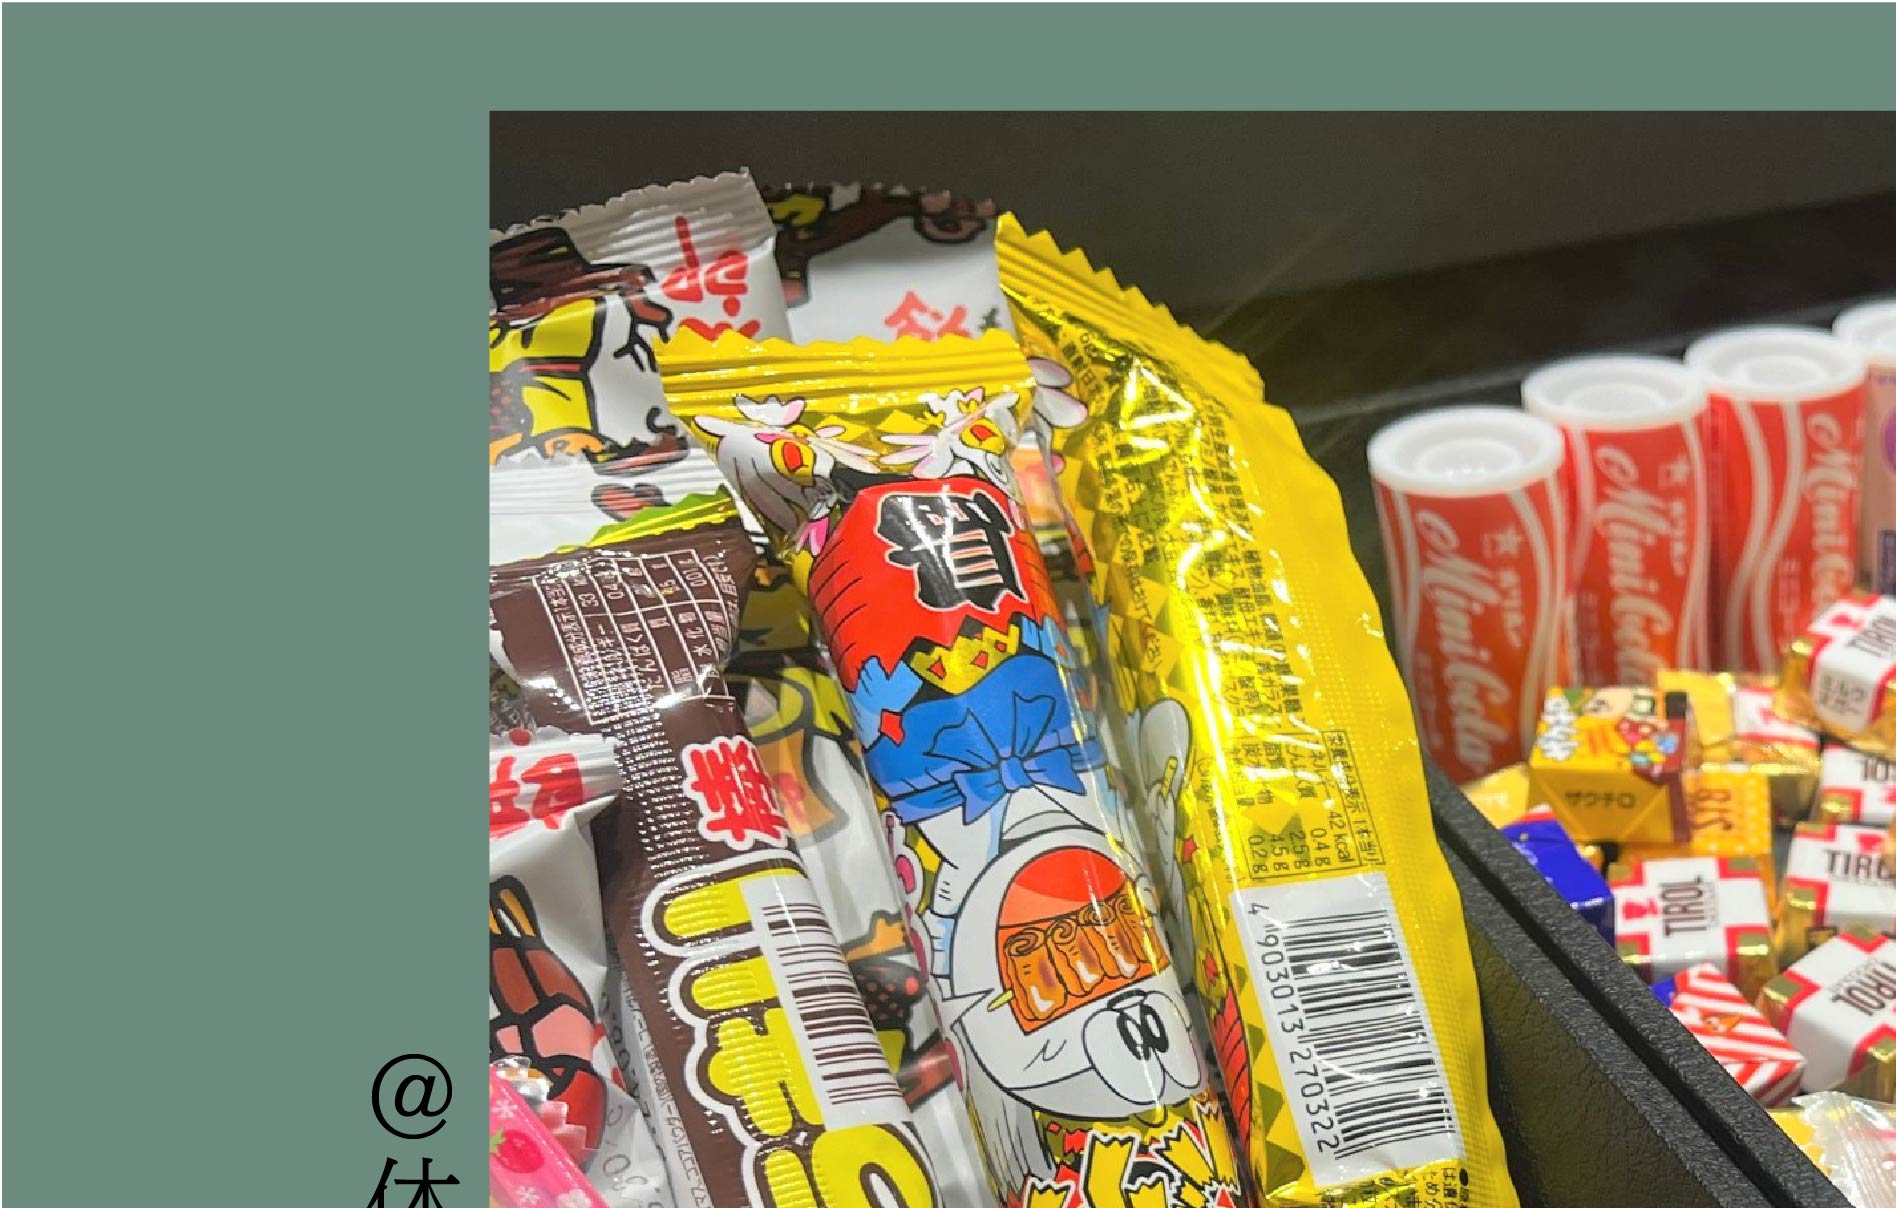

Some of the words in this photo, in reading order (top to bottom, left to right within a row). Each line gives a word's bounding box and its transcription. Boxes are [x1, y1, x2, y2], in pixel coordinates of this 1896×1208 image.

[1326, 810, 1344, 831] 42
[1247, 833, 1268, 860] 0.2
[1267, 832, 1289, 857] 4.5
[1287, 828, 1309, 855] 2.5
[1308, 826, 1329, 852] 0.4
[1332, 832, 1354, 864] kcal
[1247, 903, 1269, 922] 4
[1663, 872, 1711, 937] TIROL
[1256, 932, 1305, 1033] 903013
[1289, 1047, 1342, 1154] 270322
